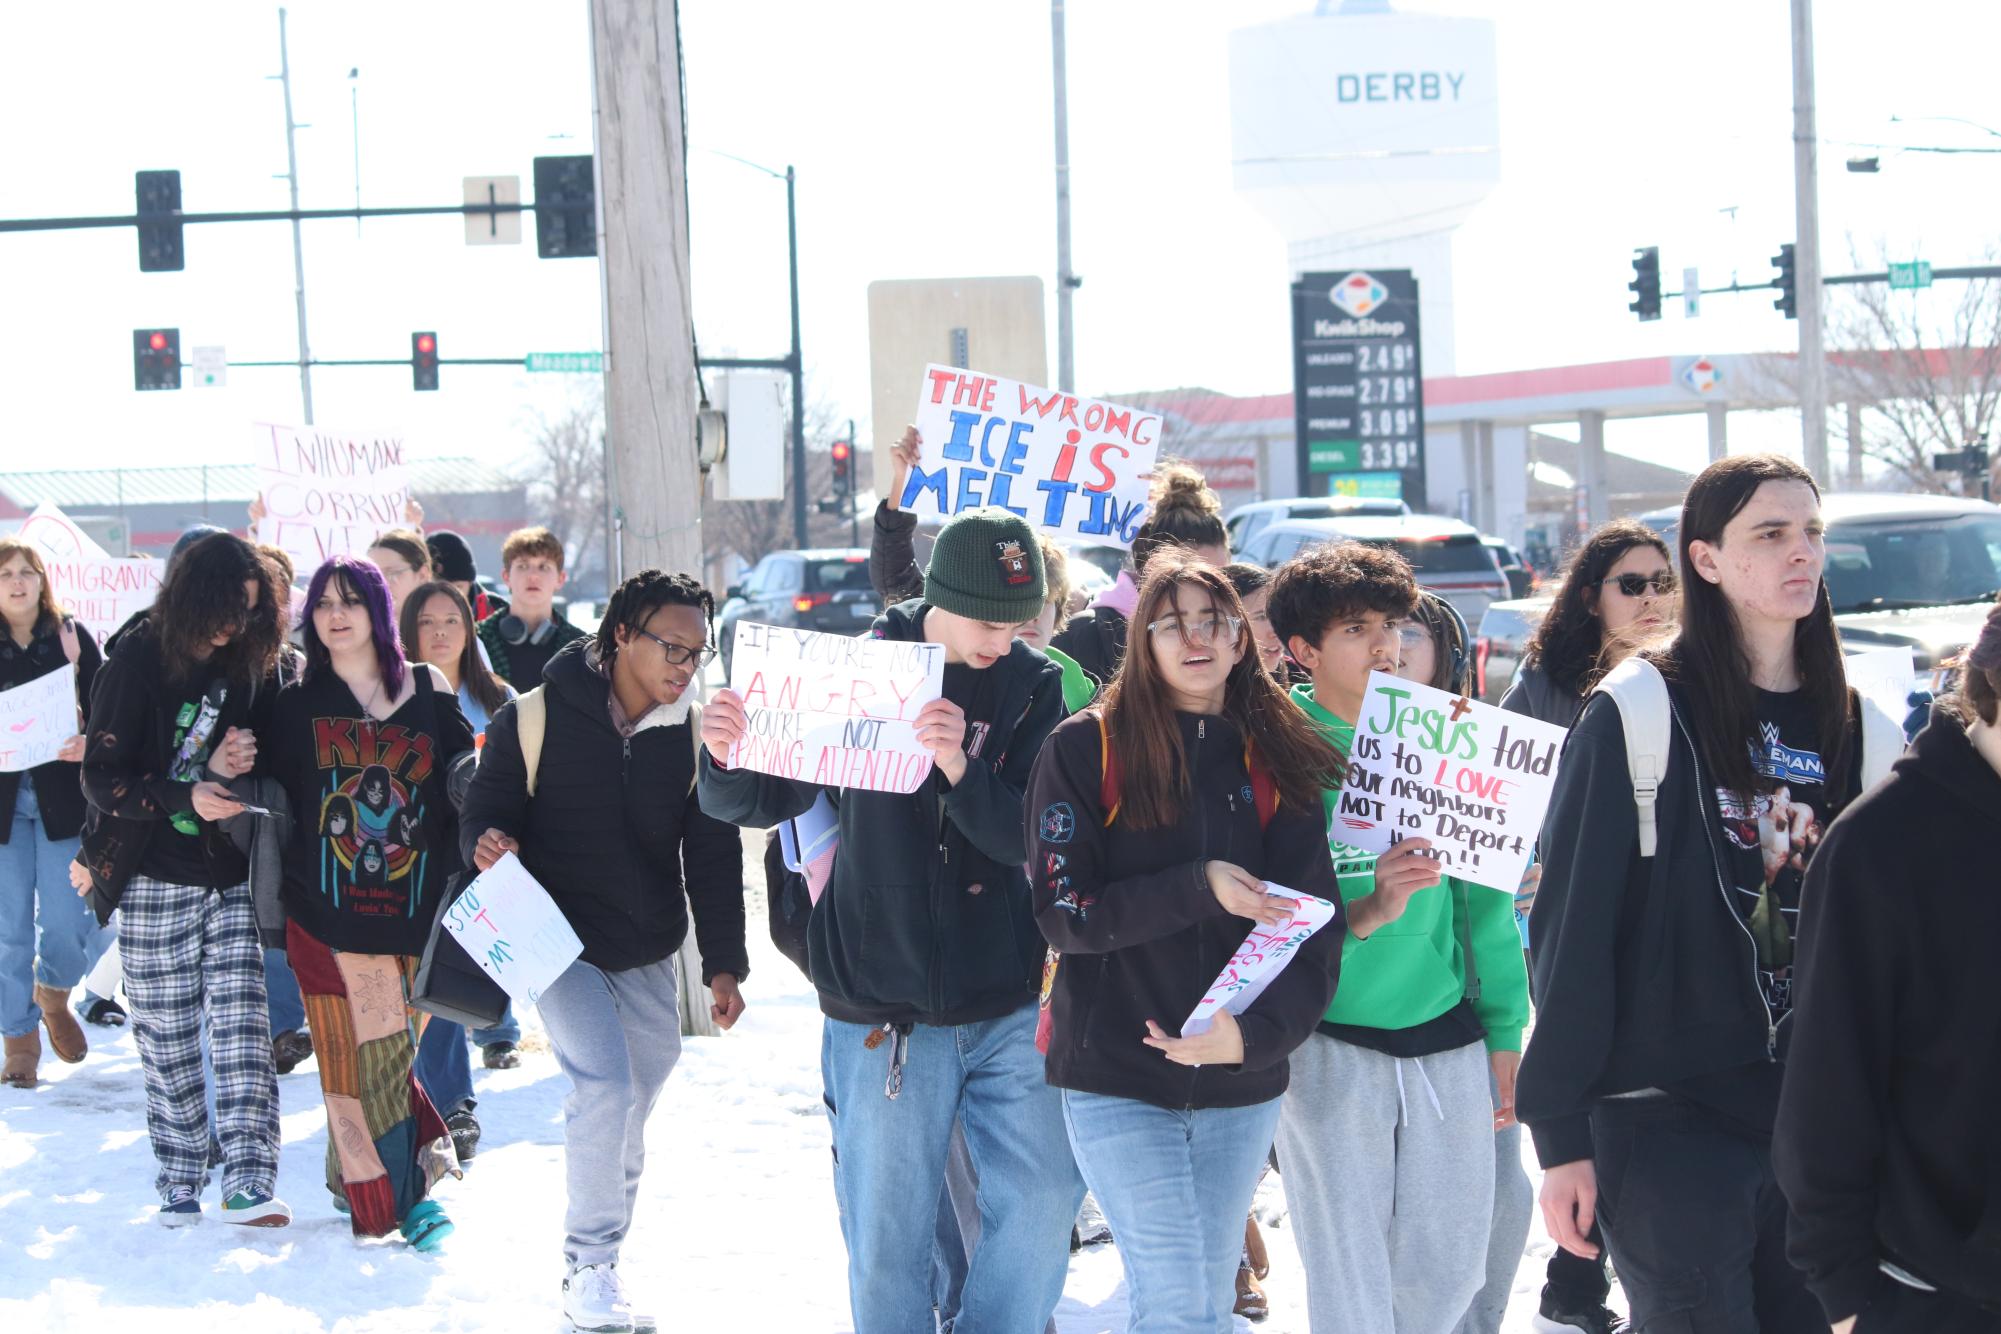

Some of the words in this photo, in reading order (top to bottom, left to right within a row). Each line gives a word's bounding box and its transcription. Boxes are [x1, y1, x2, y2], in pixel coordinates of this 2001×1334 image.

[1337, 73, 1464, 102] DERBY
[928, 369, 998, 412] THE
[1018, 384, 1157, 446] WRONG
[942, 410, 1034, 475] ICE
[900, 464, 1145, 544] MELTING
[744, 625, 780, 657] IF
[793, 630, 875, 669] YOU'RE
[890, 644, 940, 676] NOT
[743, 671, 925, 721] ANGRY
[312, 716, 433, 785] KISS
[744, 708, 803, 741] YOU'RE
[843, 718, 887, 750] NOT
[1368, 687, 1479, 760] Jesus
[1492, 725, 1557, 777] told
[735, 731, 804, 780] PAYING
[814, 745, 935, 793] ATTENTION
[1391, 742, 1422, 775] to
[1433, 759, 1520, 806] LOVE
[1340, 791, 1386, 821] NOT
[1395, 807, 1422, 829] to
[1390, 777, 1507, 826] neighbors
